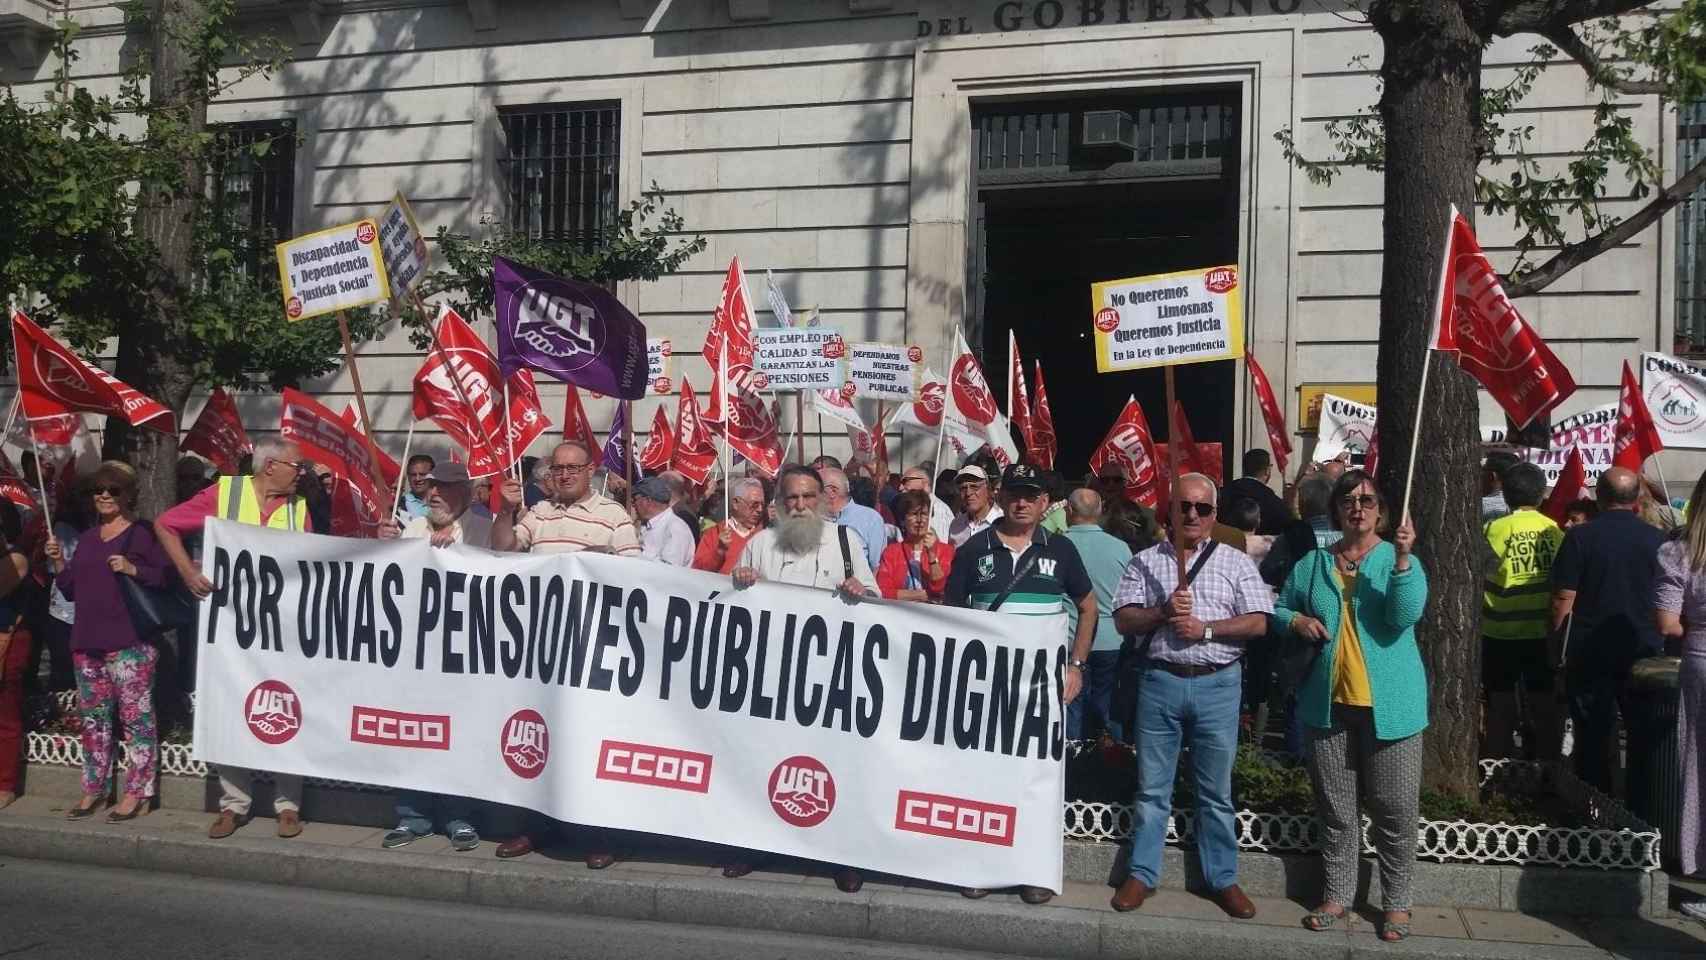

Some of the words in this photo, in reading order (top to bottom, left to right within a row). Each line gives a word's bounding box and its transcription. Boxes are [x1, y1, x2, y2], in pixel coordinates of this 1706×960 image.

[917, 17, 973, 37] DEL
[291, 238, 361, 267] Discapacidad
[300, 256, 369, 283] Dependencia
[1110, 293, 1126, 307] No
[1128, 286, 1189, 305] Queremos
[518, 287, 596, 341] UGT
[1157, 301, 1214, 319] Limosnas
[759, 335, 777, 345] CON
[779, 334, 821, 344] EMPLEO
[823, 334, 835, 342] DE
[1113, 325, 1174, 343] Queremos
[1176, 317, 1222, 336] Justicia
[760, 349, 807, 358] CALIDAD
[853, 350, 900, 360] DEFENDAMOS
[1113, 351, 1124, 361] En
[1126, 350, 1135, 360] la
[1137, 347, 1152, 359] Ley
[1154, 345, 1166, 356] de
[1167, 338, 1226, 354] Dependencia
[760, 361, 817, 370] GARANTIZAN
[852, 371, 896, 381] PENSIONES
[872, 362, 909, 371] NUESTRAS
[768, 373, 829, 383] PENSIONES
[868, 383, 909, 394] PUBLICAS
[207, 546, 284, 651] POR
[298, 560, 404, 668] UNAS
[415, 567, 648, 697] PENSIONES
[659, 590, 889, 738] PÚBLICAS
[900, 631, 1067, 762] DIGNAS
[252, 688, 295, 716] UGT
[357, 714, 444, 742] CCOO
[509, 719, 545, 746] UGT
[605, 749, 704, 784] CCOO
[782, 765, 829, 796] UGT
[903, 800, 1006, 837] CCOO
